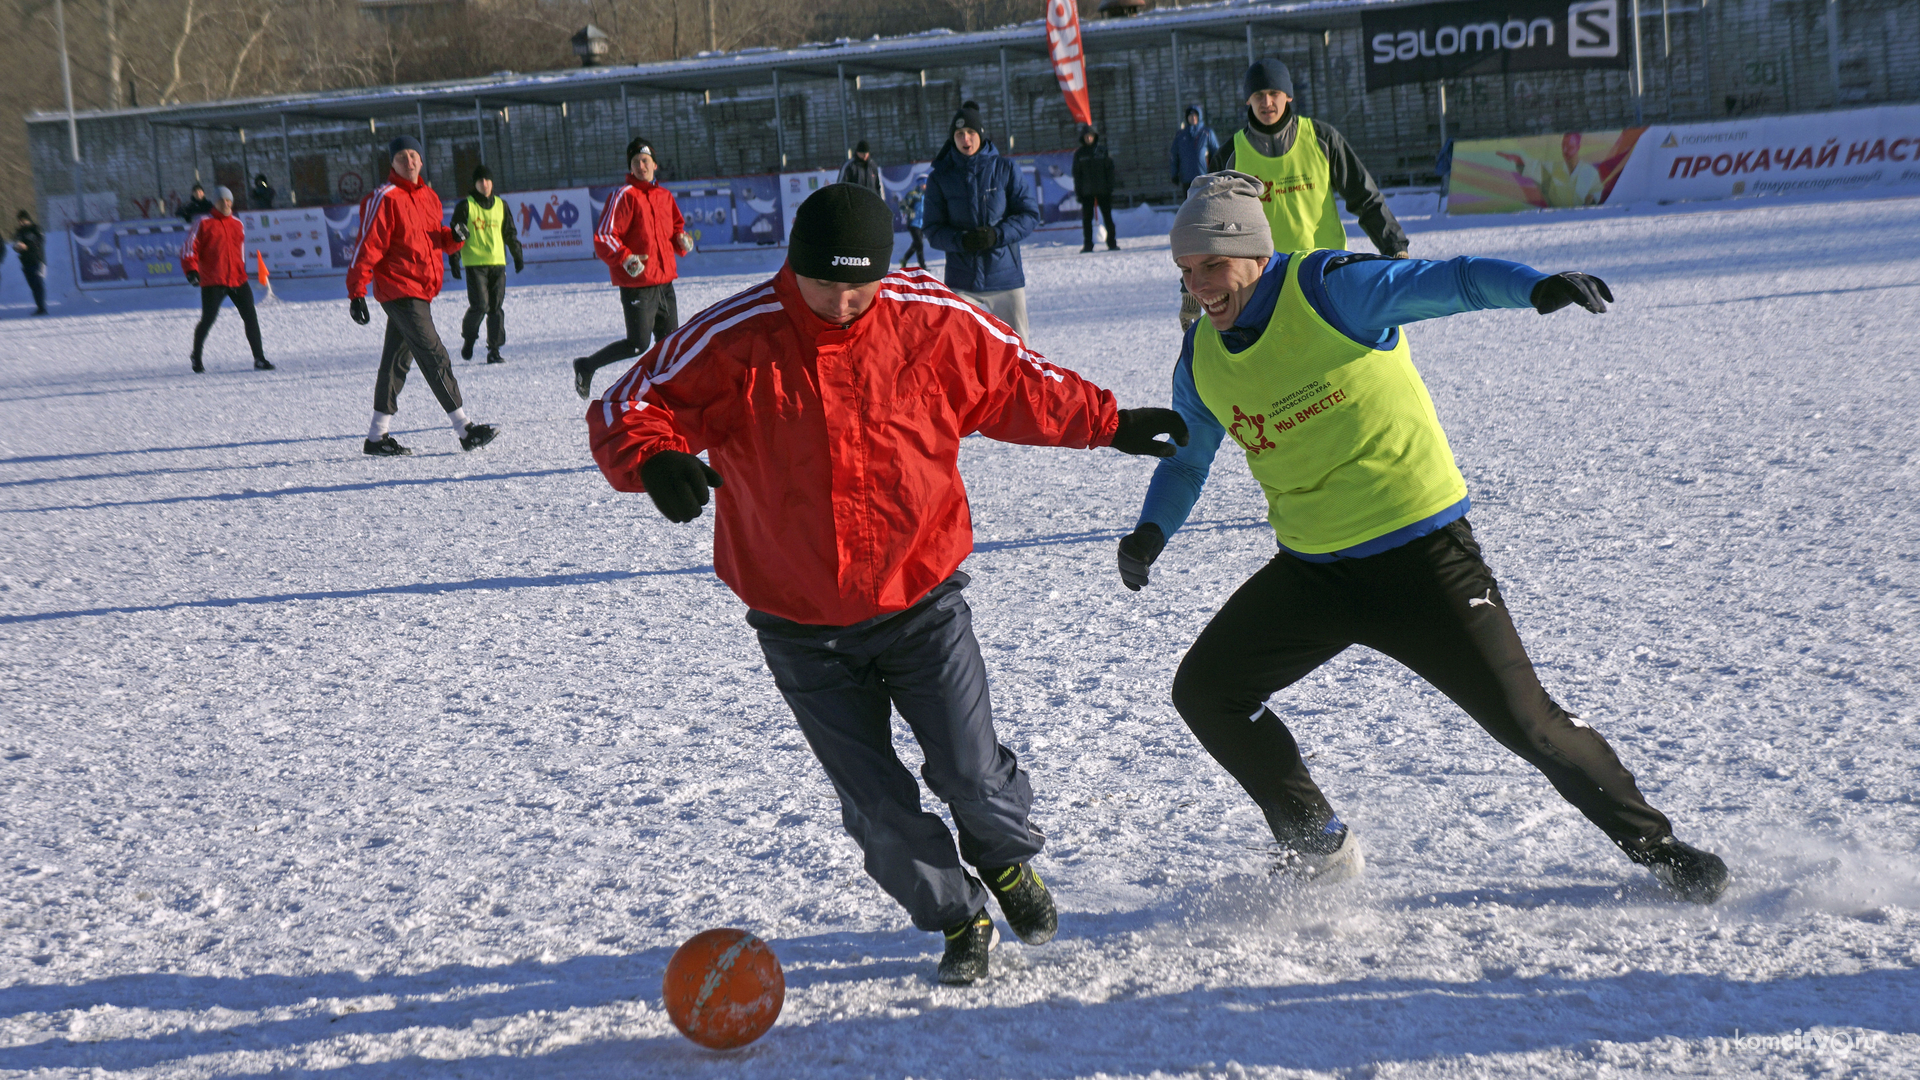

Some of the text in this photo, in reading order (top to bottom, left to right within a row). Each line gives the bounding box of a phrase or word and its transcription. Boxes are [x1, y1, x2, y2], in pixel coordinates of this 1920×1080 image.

[1681, 131, 1748, 145] ПОЛИМЕТАЛЛ
[1668, 137, 1841, 179] ПРОКАЧАЙ
[147, 262, 173, 275] 2019
[1267, 381, 1332, 419] ХАБАРОВСКОГО КРАЯ
[1272, 381, 1318, 408] ПРАВИТЕЛЬСТВО
[1274, 388, 1346, 433] МЫ ВМЕСТЕ!
[996, 866, 1014, 882] umbro
